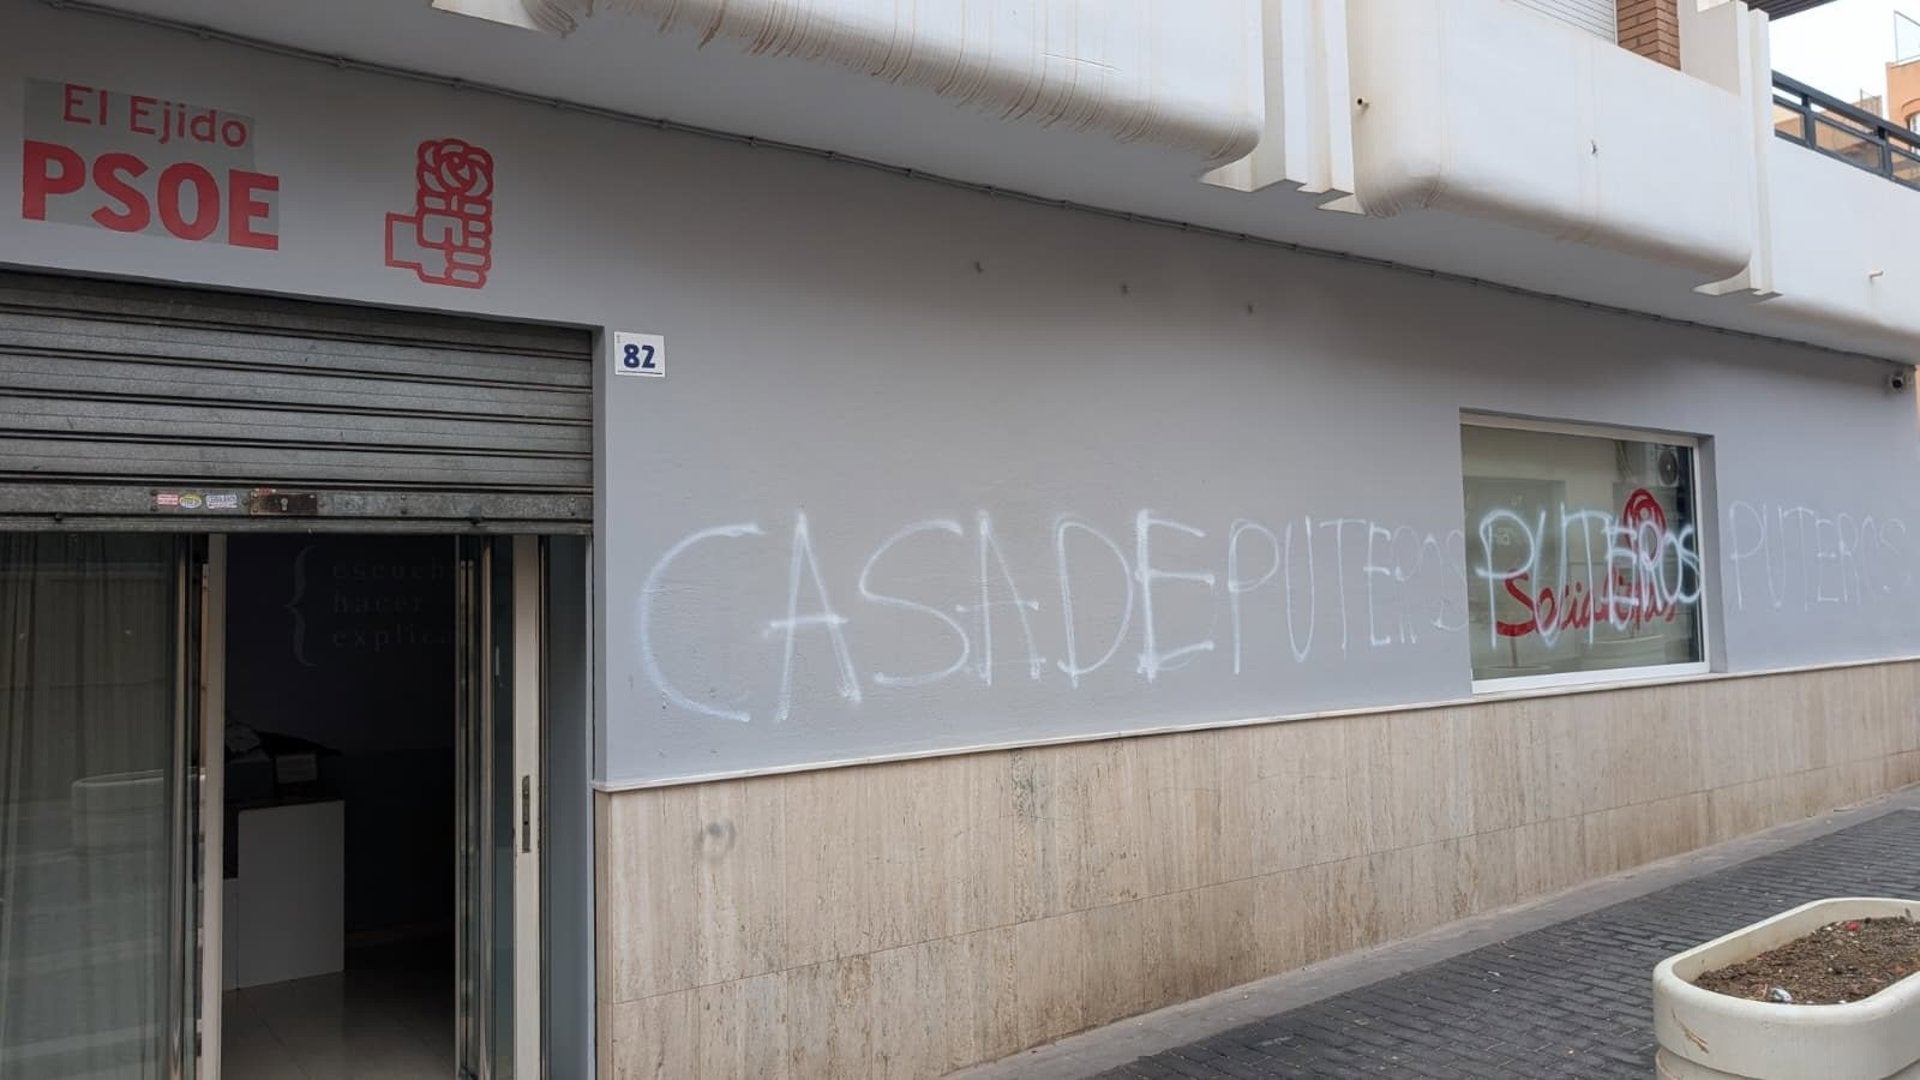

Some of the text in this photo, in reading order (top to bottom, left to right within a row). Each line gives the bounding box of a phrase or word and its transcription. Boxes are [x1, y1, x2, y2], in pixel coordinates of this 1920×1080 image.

[63, 83, 248, 147] El Ejido
[22, 139, 279, 250] PSOE
[623, 343, 656, 369] 82
[1475, 501, 1701, 649] PUTEROS
